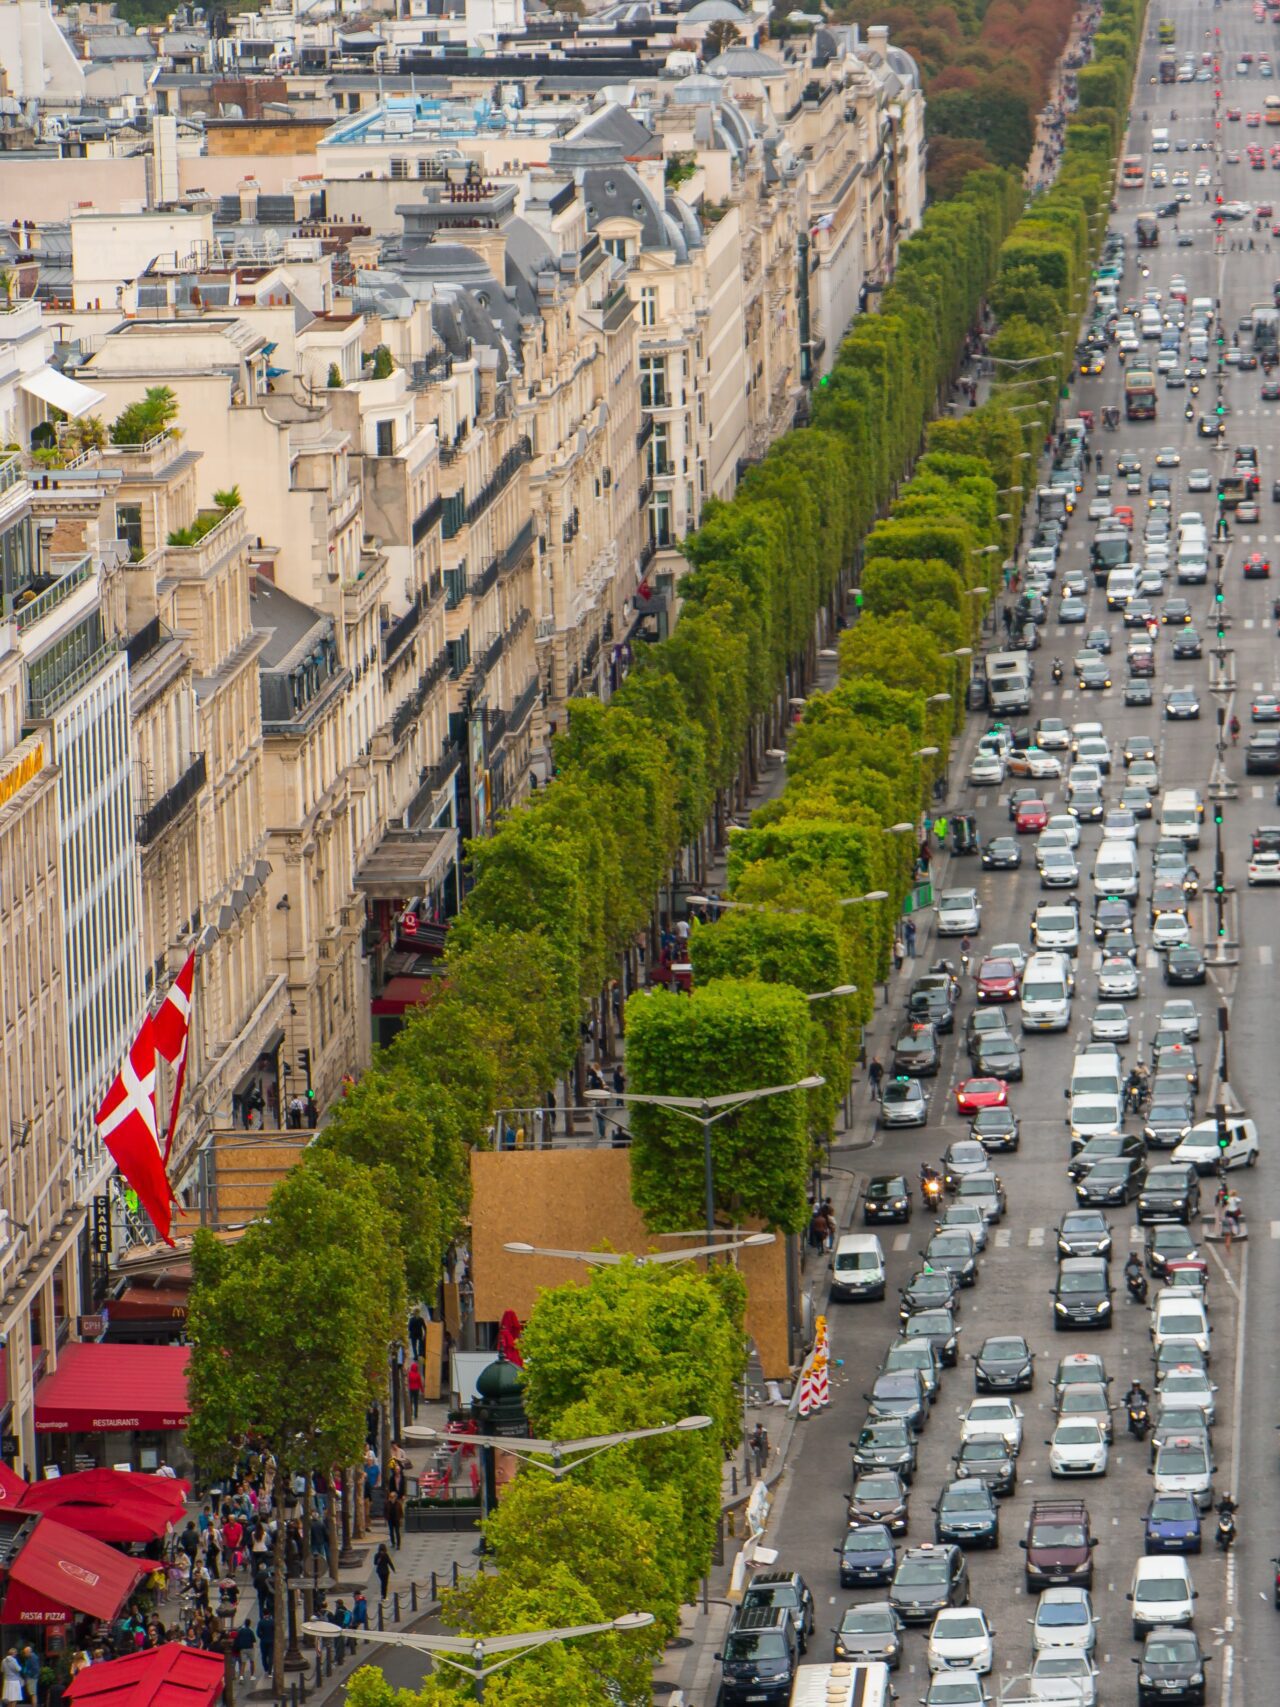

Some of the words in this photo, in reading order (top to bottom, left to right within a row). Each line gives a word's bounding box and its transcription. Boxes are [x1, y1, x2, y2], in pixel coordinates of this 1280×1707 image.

[97, 1198, 108, 1251] CHANGE
[83, 1321, 101, 1330] CPH
[92, 1418, 140, 1427] RESTAURANTS
[20, 1611, 43, 1620] PASTA
[45, 1612, 66, 1620] PIZZA
